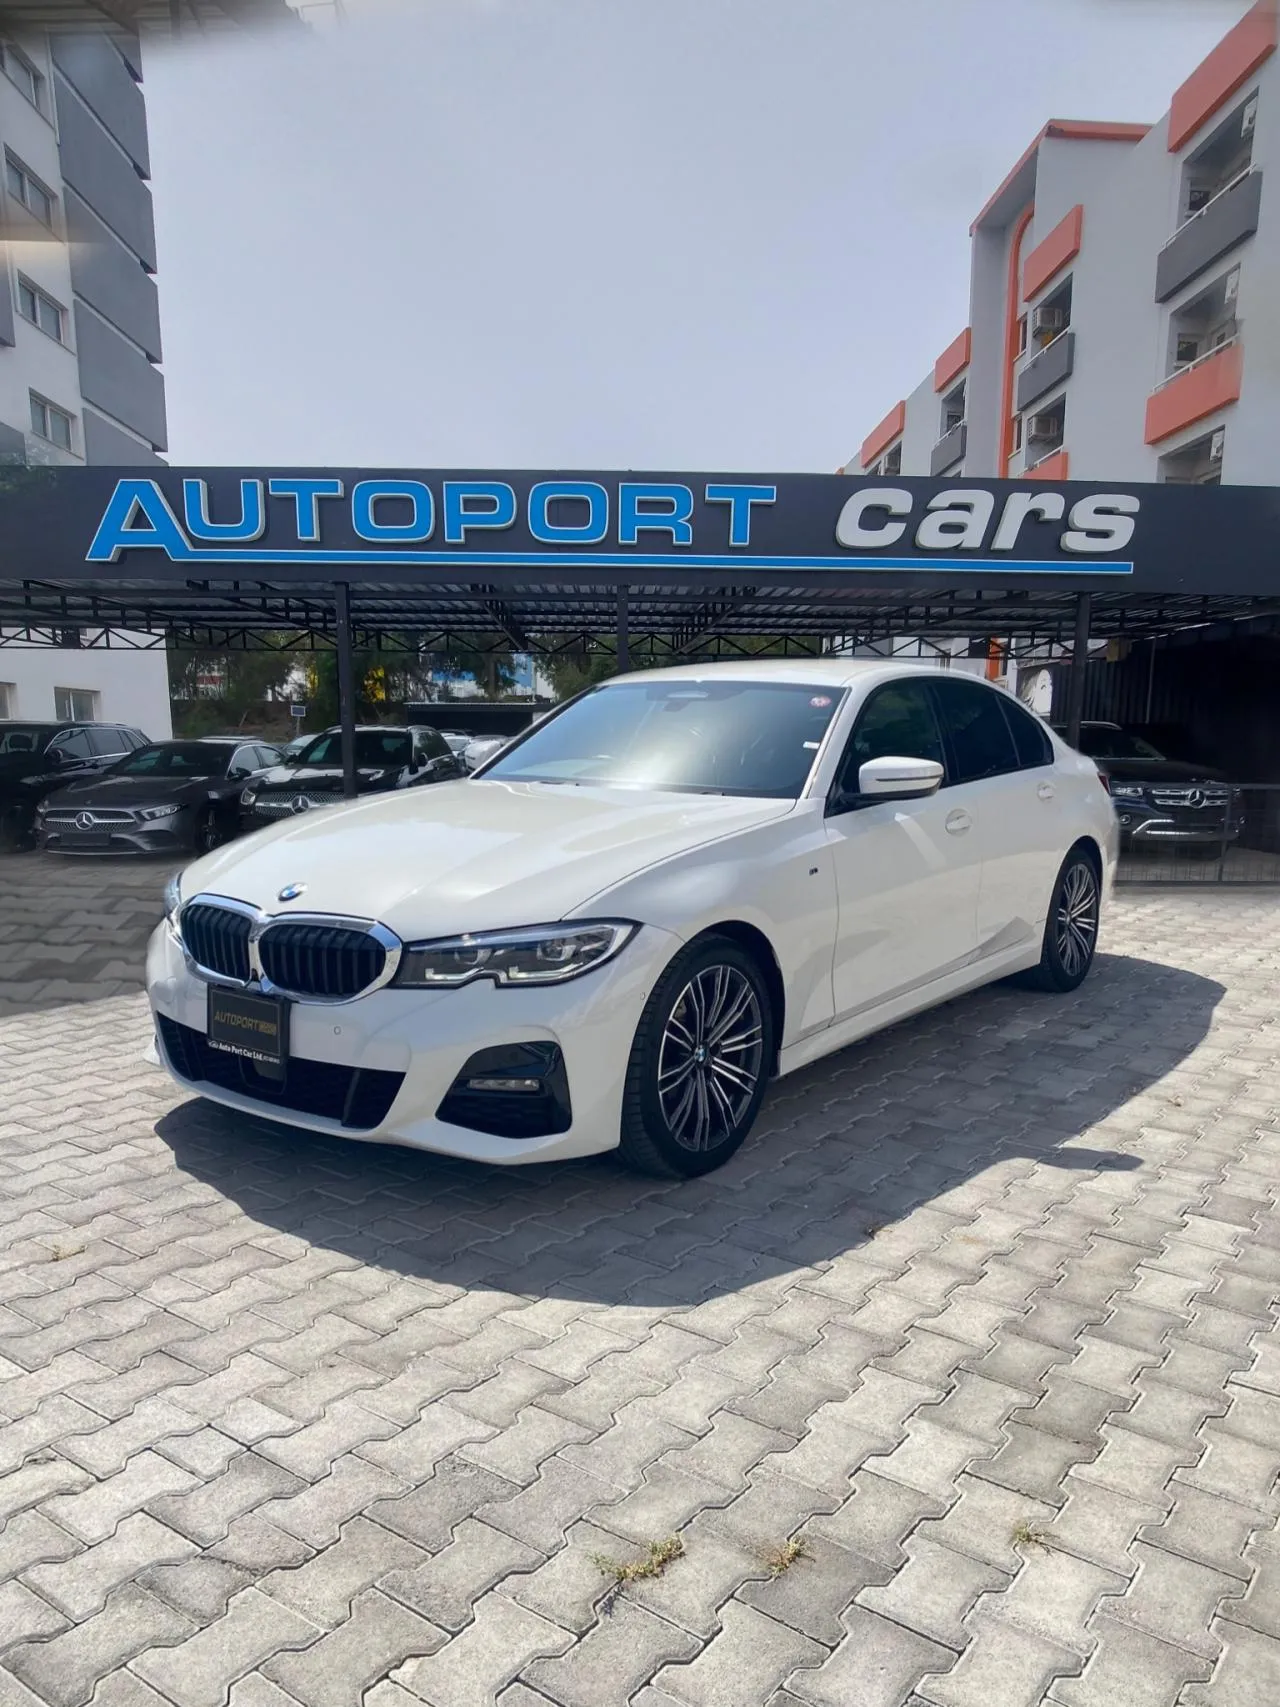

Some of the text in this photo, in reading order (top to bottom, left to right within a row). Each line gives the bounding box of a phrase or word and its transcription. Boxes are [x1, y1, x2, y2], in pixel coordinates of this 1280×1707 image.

[85, 477, 1141, 561] AUTOPORT cars
[214, 1010, 258, 1031] AUTOPORT
[219, 1042, 231, 1052] Auto
[232, 1045, 243, 1056] Port
